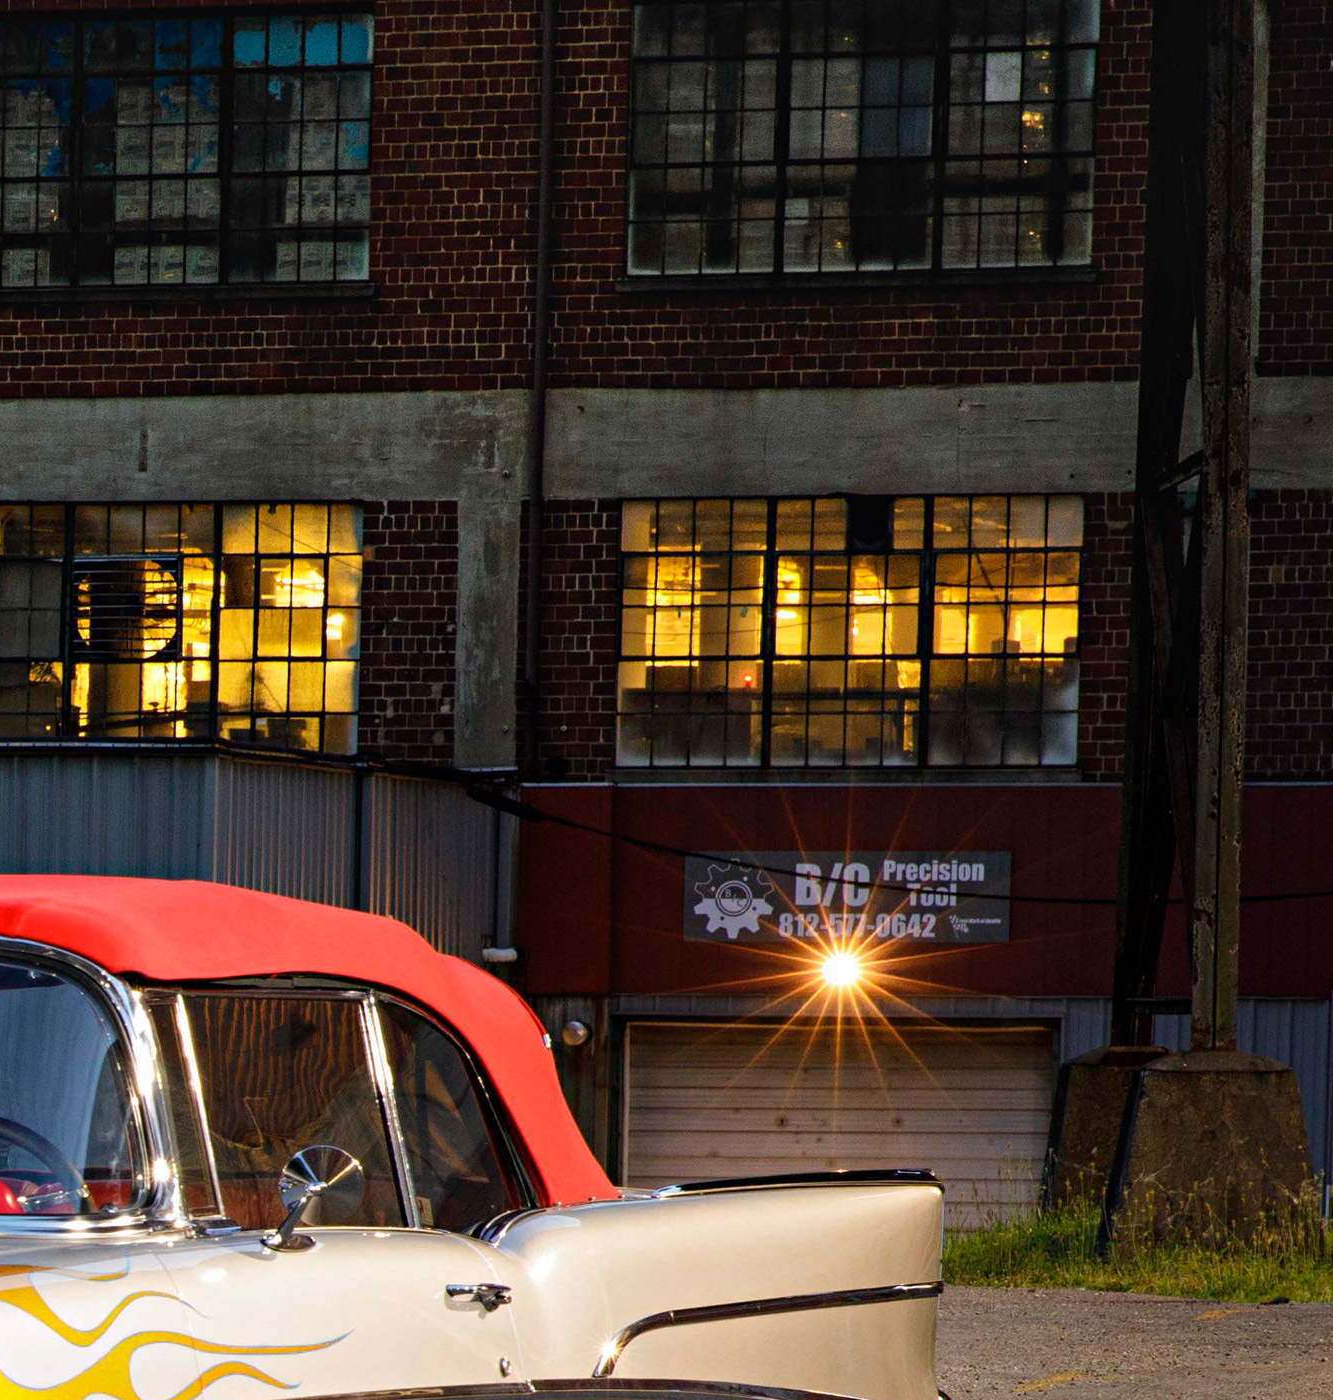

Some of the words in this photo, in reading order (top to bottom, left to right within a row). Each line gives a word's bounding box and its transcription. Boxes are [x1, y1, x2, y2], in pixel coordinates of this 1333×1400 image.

[883, 859, 984, 881] Precision
[795, 863, 870, 907] B/C
[906, 883, 957, 907] Tool
[779, 913, 936, 938] 812-577-0642
